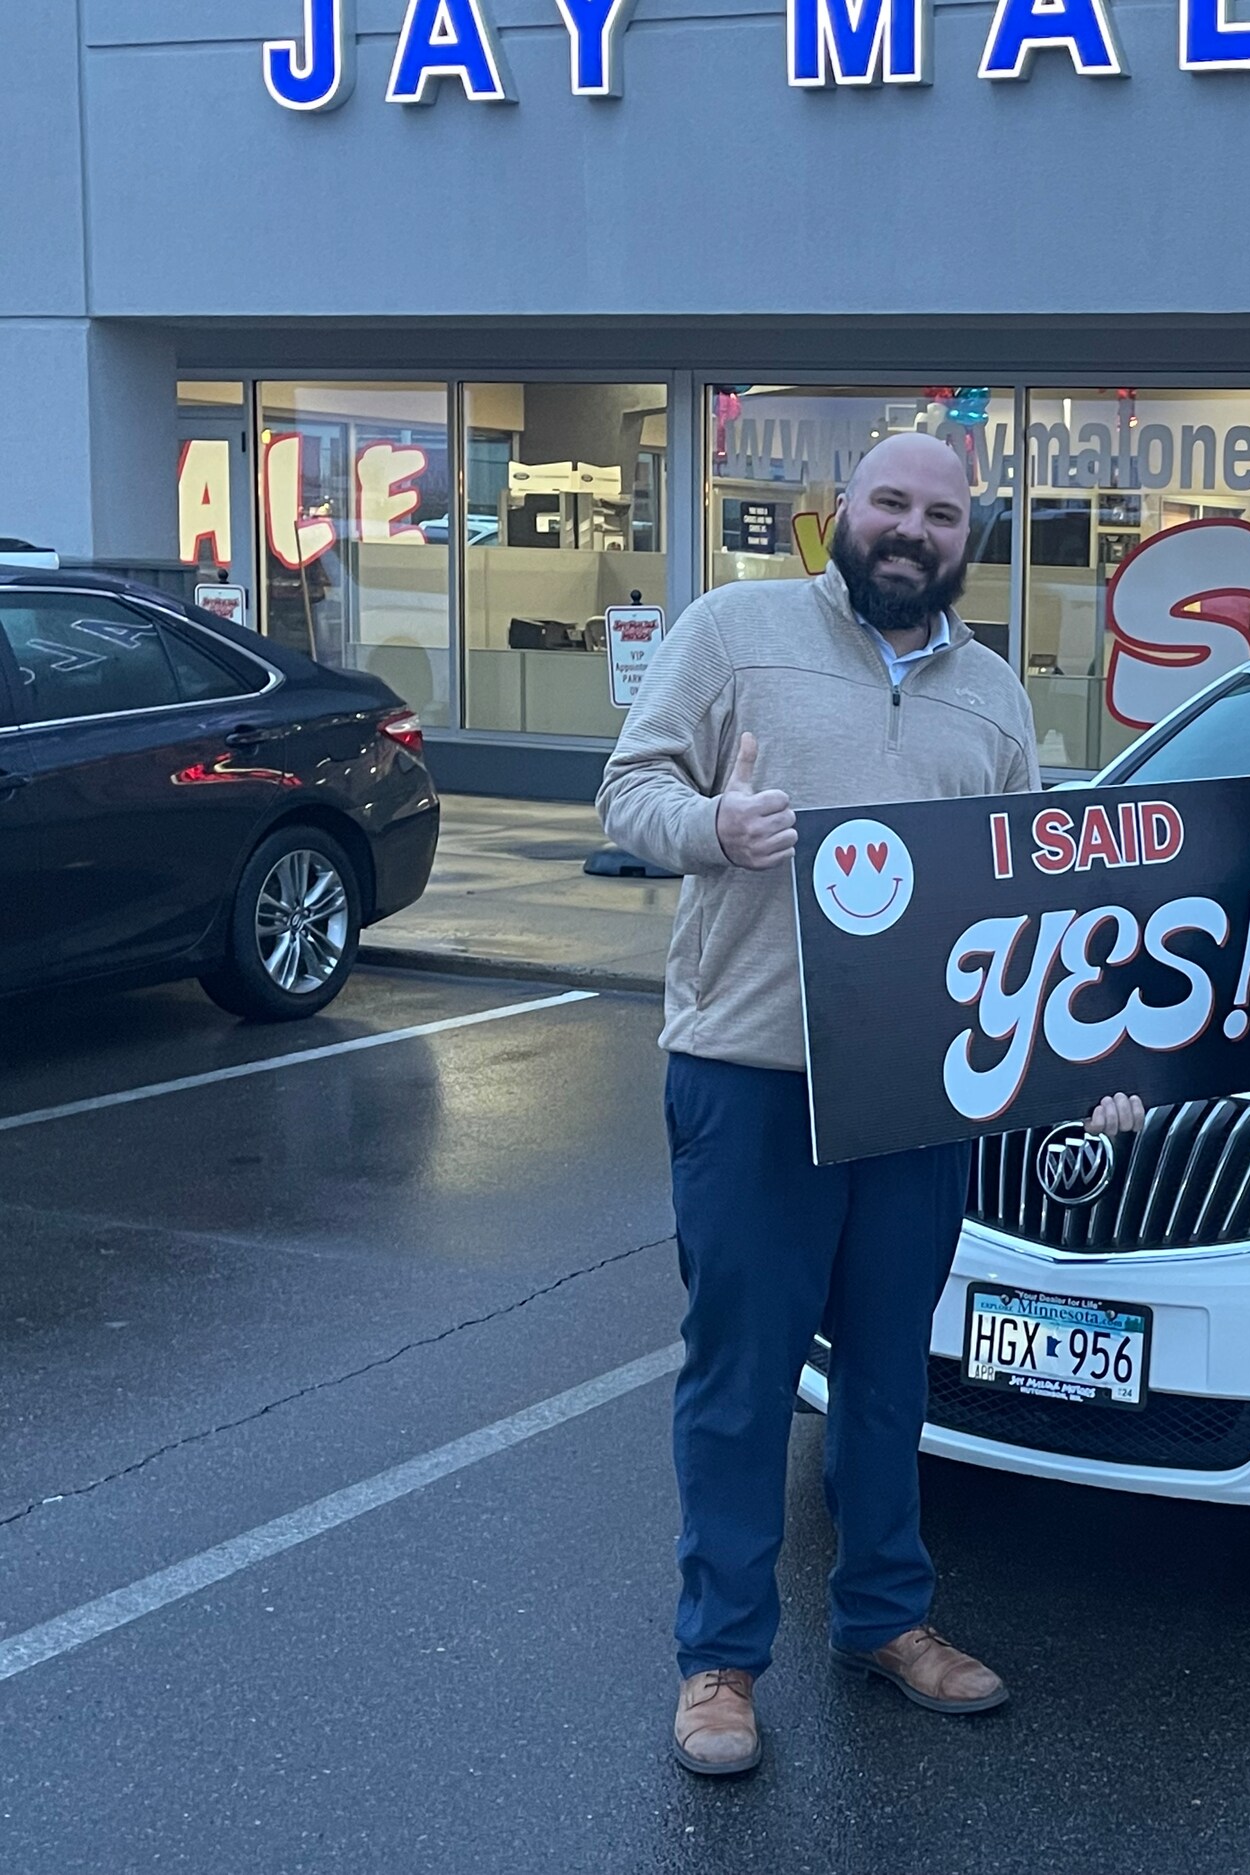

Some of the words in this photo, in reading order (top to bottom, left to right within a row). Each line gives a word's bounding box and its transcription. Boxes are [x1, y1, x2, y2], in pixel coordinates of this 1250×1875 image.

[263, 0, 624, 111] JAY
[630, 650, 645, 661] VIP
[622, 674, 642, 683] PARK
[990, 812, 1013, 880] I
[1031, 800, 1185, 874] SAID
[1039, 1293, 1067, 1305] Dealer
[1067, 1297, 1080, 1307] for
[1017, 1299, 1098, 1324] Minnesota
[975, 1314, 1040, 1370] HGX
[1069, 1328, 1132, 1383] 956
[975, 1365, 994, 1382] APR
[1122, 1388, 1133, 1398] 24
